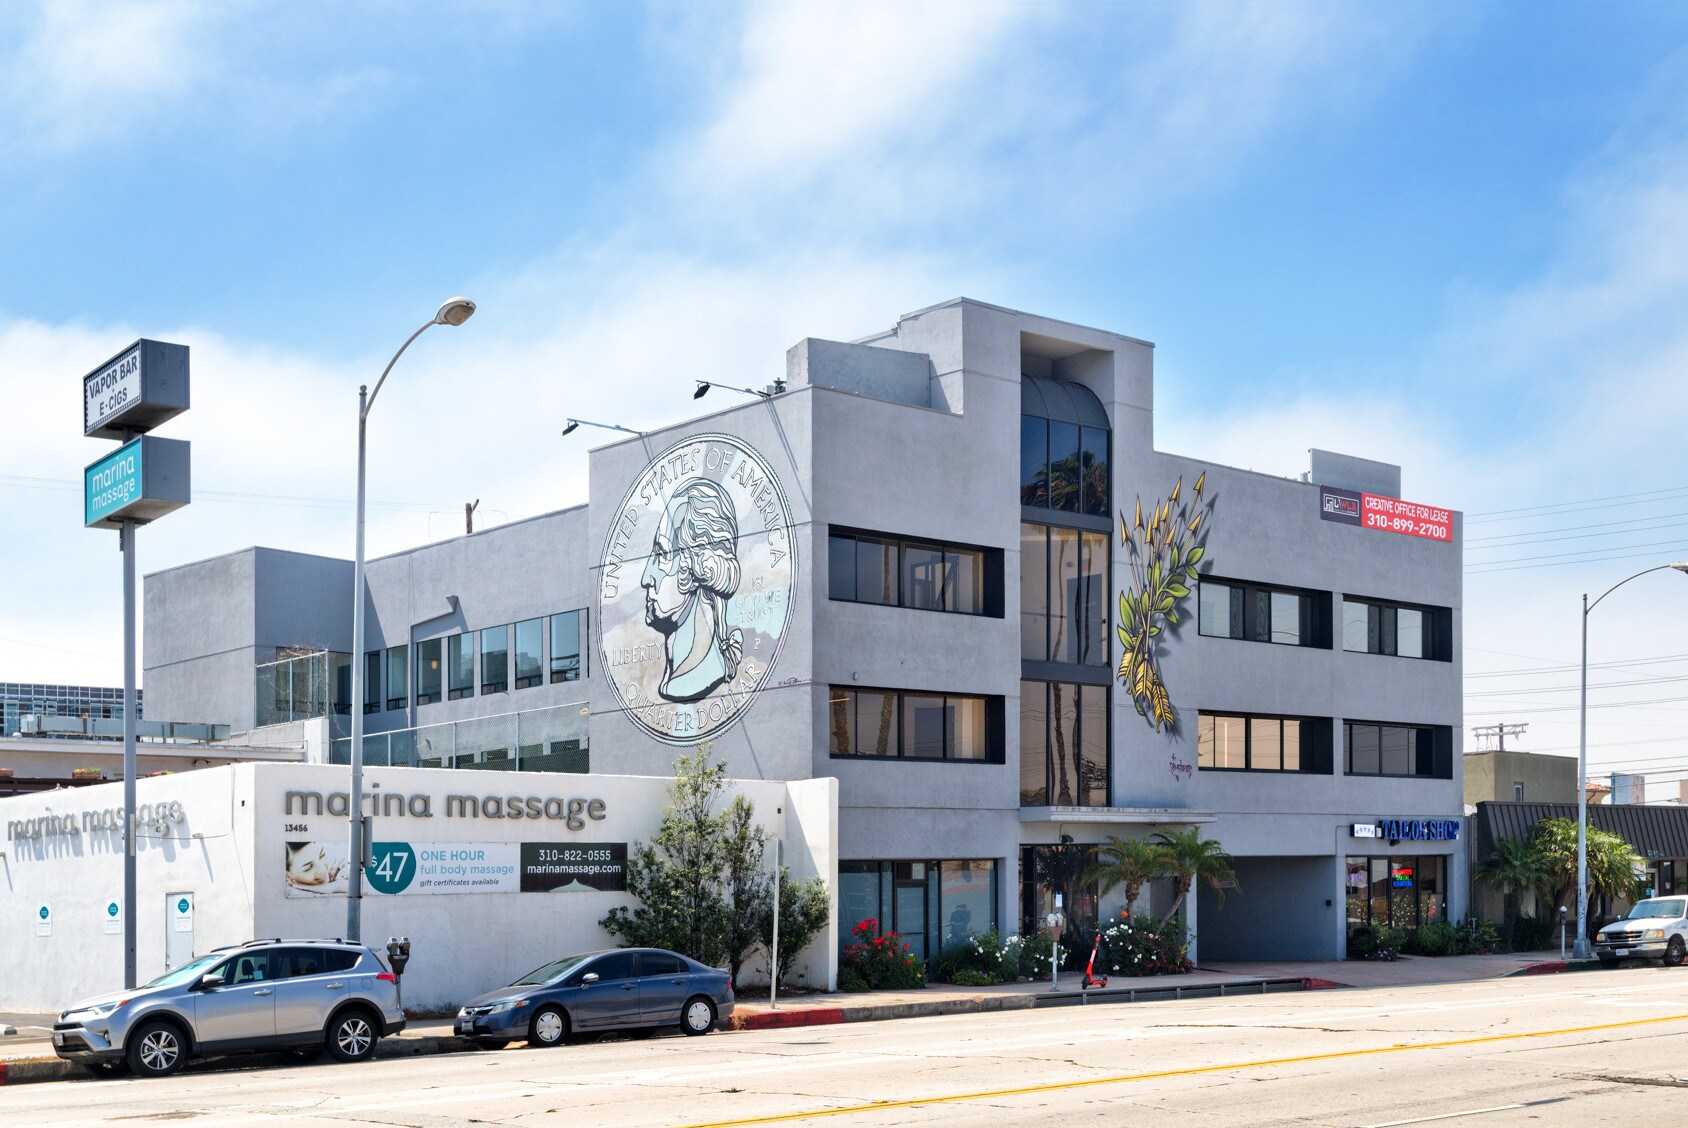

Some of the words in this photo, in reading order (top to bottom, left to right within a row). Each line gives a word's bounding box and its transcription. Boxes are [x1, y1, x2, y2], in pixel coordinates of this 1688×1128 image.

[89, 368, 117, 399] VAPOR
[120, 355, 138, 380] BAR
[92, 455, 135, 494] marina
[92, 477, 135, 512] massage
[1365, 496, 1394, 513] CREATIVE
[1394, 502, 1416, 517] OFFICE
[1416, 507, 1429, 520] FOR
[1429, 509, 1449, 524] LEASE
[604, 507, 639, 599] UNITED
[640, 449, 700, 505] STATES
[706, 447, 733, 473] OF
[731, 459, 786, 569] AMERICA
[1367, 513, 1447, 539] 310-899-2700
[735, 593, 760, 608] GOD
[765, 589, 781, 603] WE
[740, 605, 776, 622] TRUST
[612, 643, 664, 667] LIBERTY
[626, 682, 695, 732] QUARTER
[697, 663, 761, 730] DOLLAR
[7, 813, 78, 841] marina
[82, 800, 184, 836] masage
[447, 795, 606, 831] massage
[285, 824, 308, 832] 13456
[1382, 820, 1427, 840] TAILOR
[421, 850, 447, 861] ONE
[450, 850, 485, 861] HOUR
[539, 850, 611, 861] 310-822-0555
[420, 864, 437, 875] full
[440, 864, 467, 877] body
[470, 865, 514, 877] massage
[527, 863, 622, 874] marinamassage.com
[419, 880, 432, 888] gift
[434, 879, 470, 887] certificates
